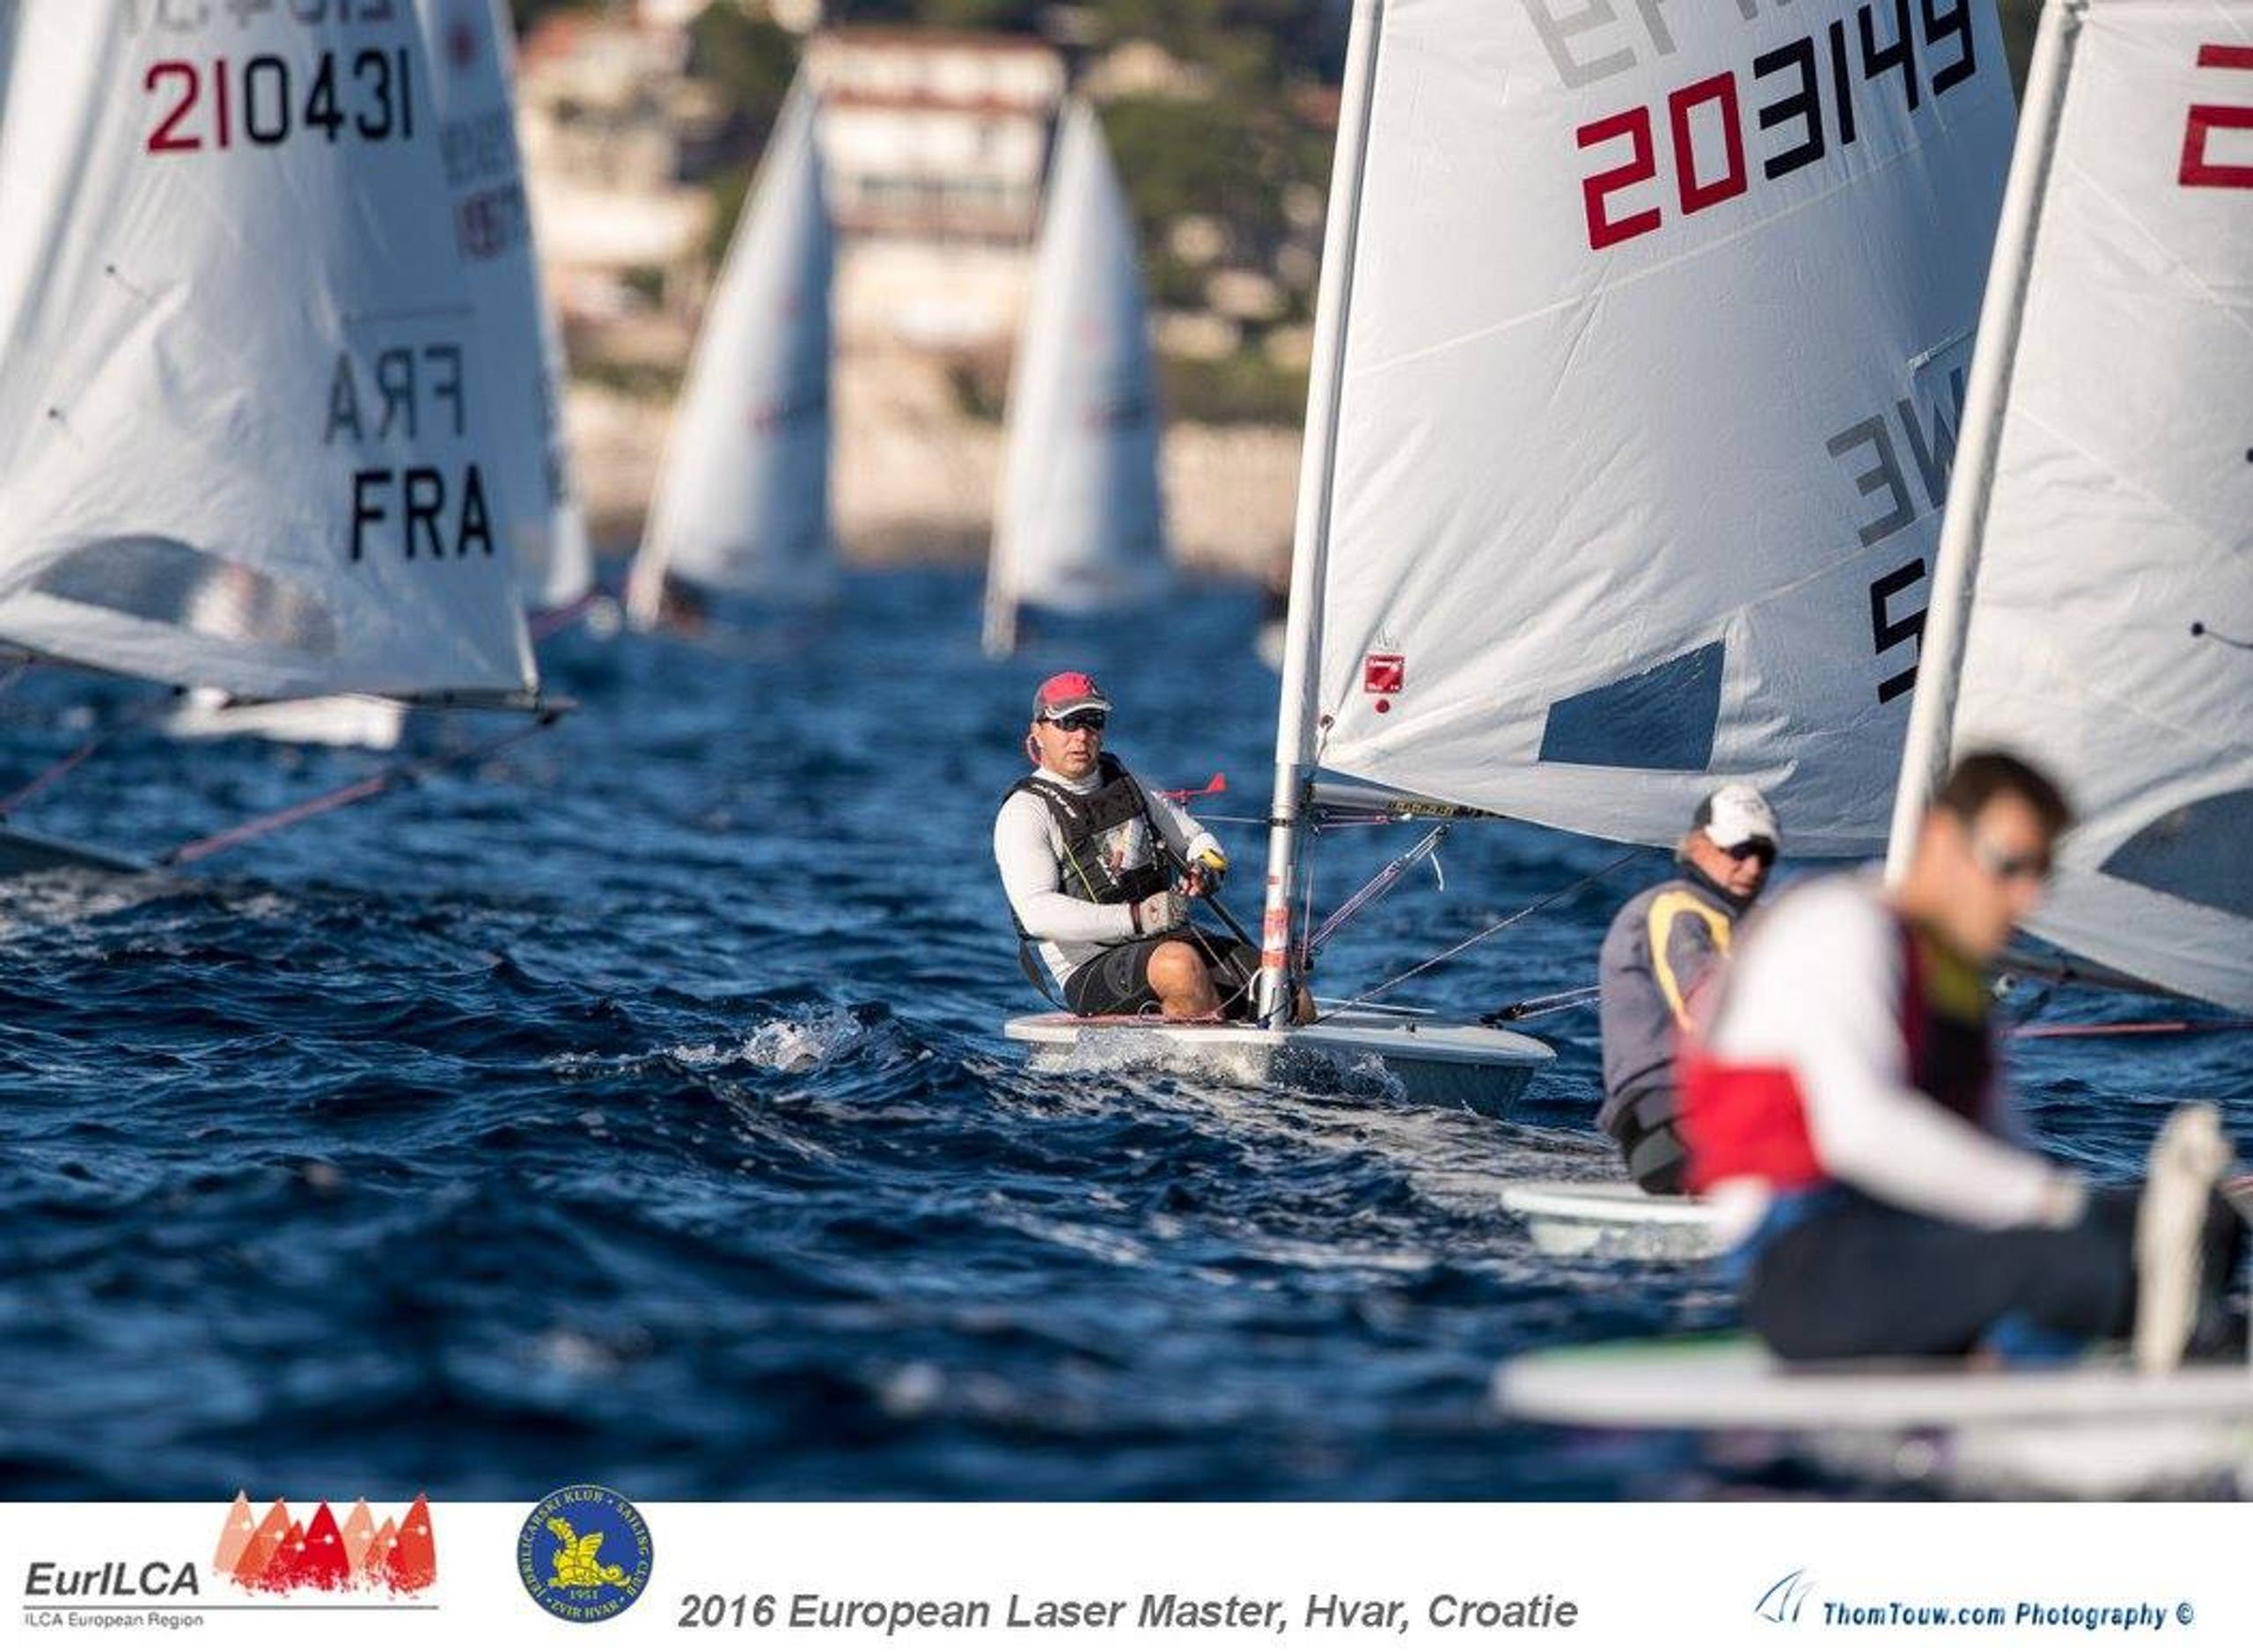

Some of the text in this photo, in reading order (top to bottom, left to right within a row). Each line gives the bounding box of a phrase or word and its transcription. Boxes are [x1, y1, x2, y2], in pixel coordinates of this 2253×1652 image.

[144, 49, 414, 155] 210431
[1576, 0, 1977, 250] 203149
[351, 464, 494, 562] FRA
